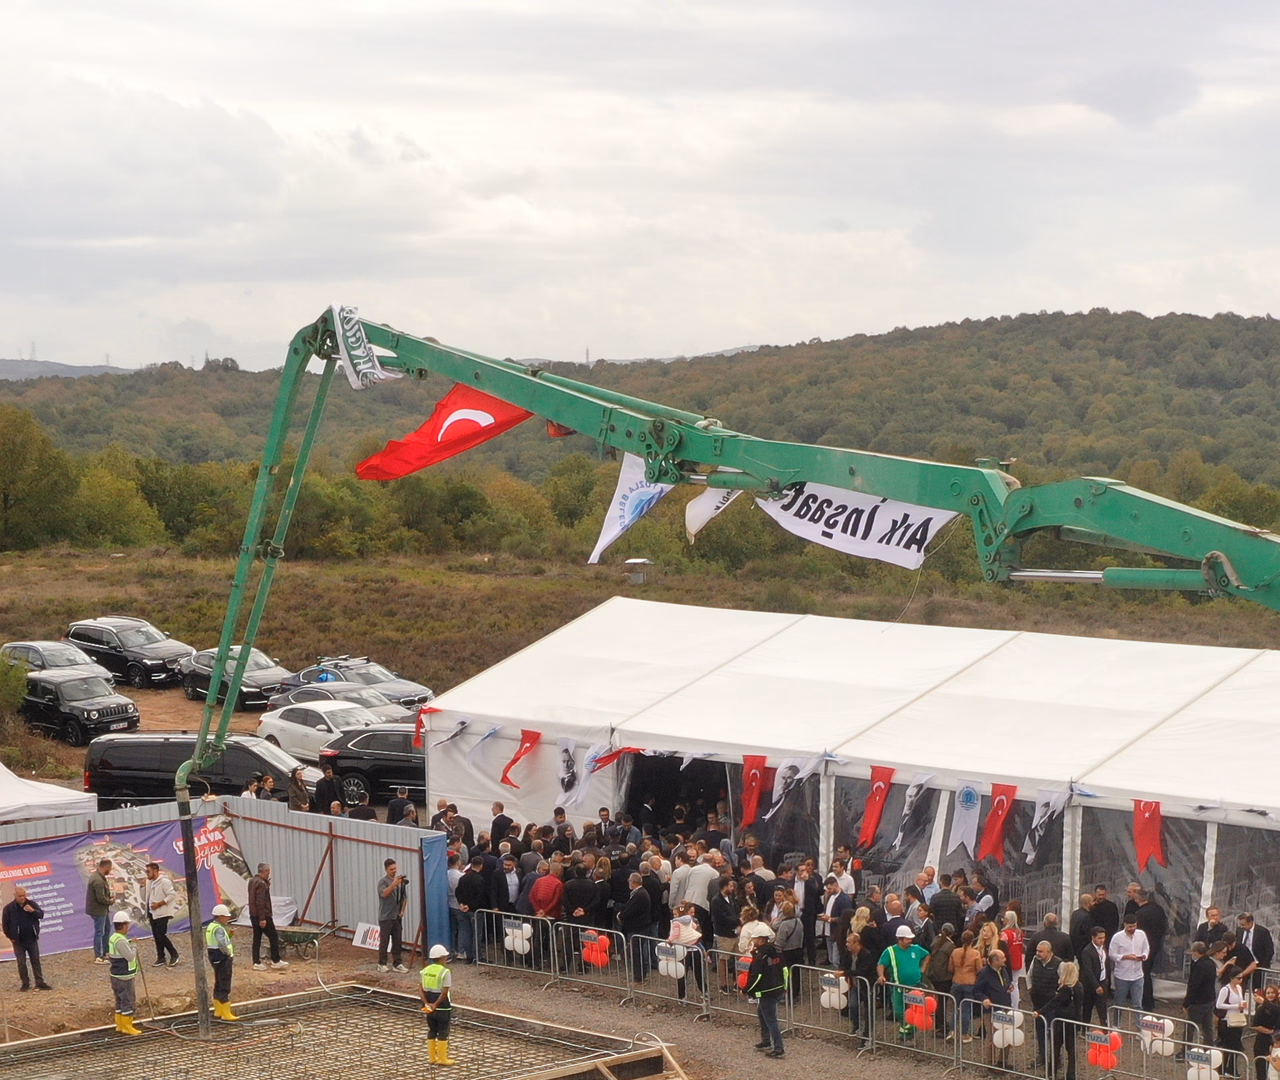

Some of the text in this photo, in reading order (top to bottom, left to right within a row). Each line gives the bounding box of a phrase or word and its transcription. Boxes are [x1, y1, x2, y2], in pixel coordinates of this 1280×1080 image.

[580, 934, 598, 943] TUZLA
[657, 947, 676, 957] TUZLA
[820, 977, 839, 988] TUZLA
[904, 994, 924, 1006] TUZLA
[992, 1013, 1014, 1025] TUZLA
[1086, 1032, 1109, 1045] TUZLA
[1186, 1053, 1210, 1064] TUZLA
